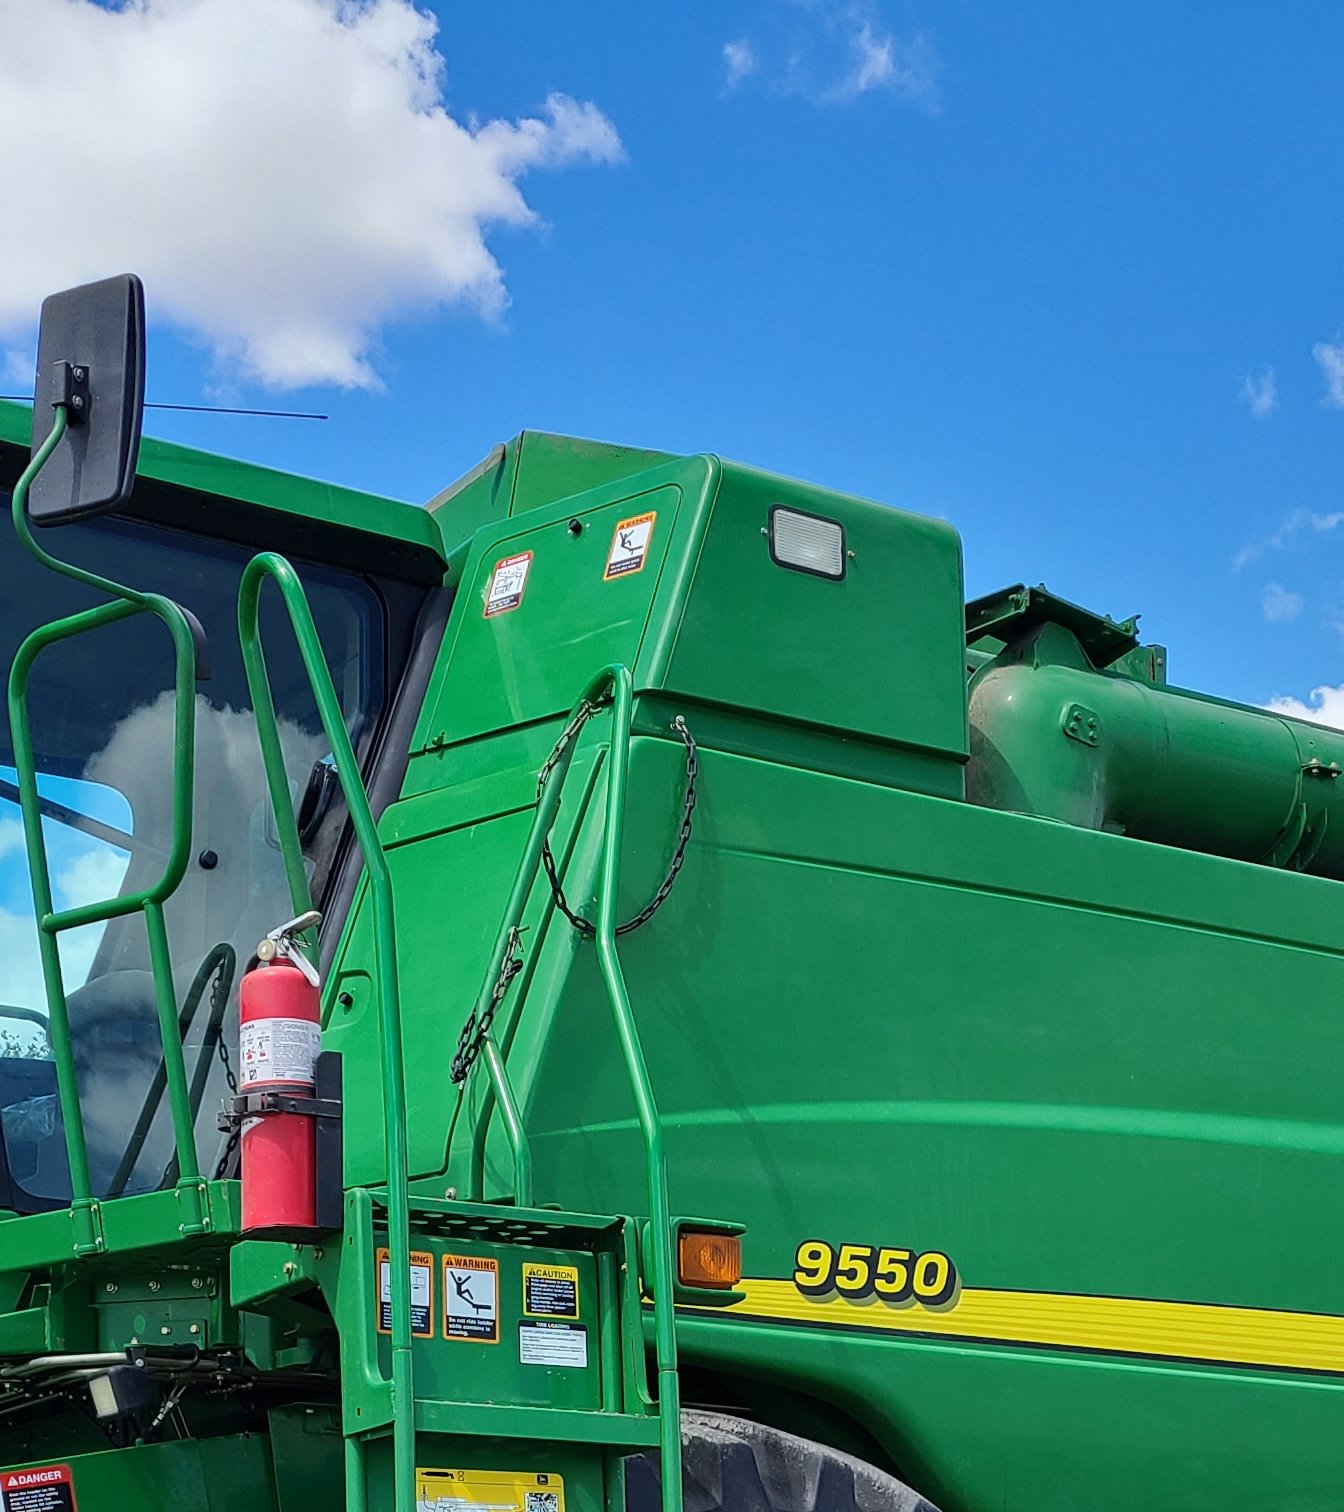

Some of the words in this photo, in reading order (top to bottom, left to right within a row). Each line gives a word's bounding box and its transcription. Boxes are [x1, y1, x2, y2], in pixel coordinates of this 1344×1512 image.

[454, 1257, 496, 1271] WARNING
[536, 1269, 573, 1279] CAUTION
[793, 1240, 956, 1305] 9550
[18, 1470, 62, 1485] DANGER
